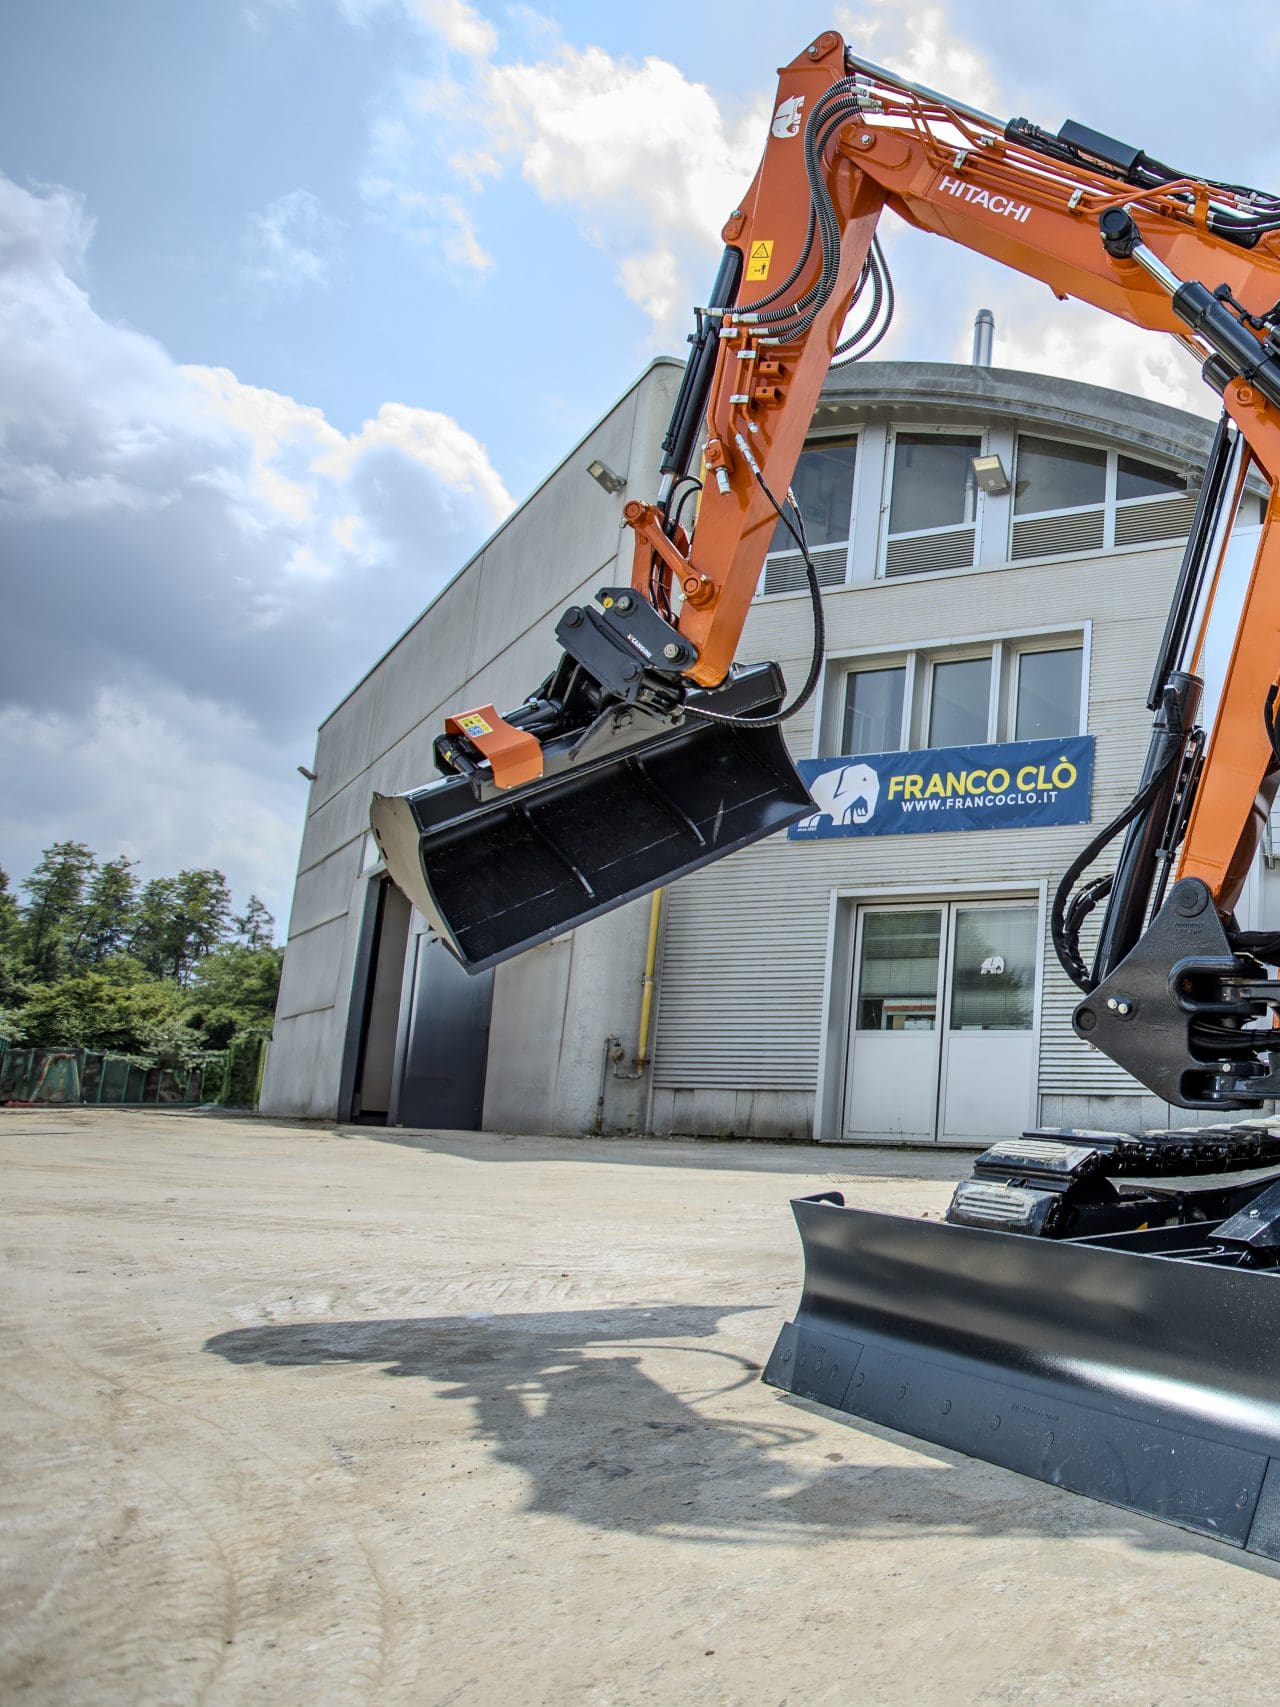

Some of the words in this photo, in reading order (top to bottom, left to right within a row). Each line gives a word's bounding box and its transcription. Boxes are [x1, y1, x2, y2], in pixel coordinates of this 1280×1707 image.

[939, 176, 1032, 223] HITACHI
[888, 768, 1010, 800] FRANCO
[1016, 755, 1077, 791] CLÒ
[901, 791, 1058, 812] WWW.FRANCOCLO.IT
